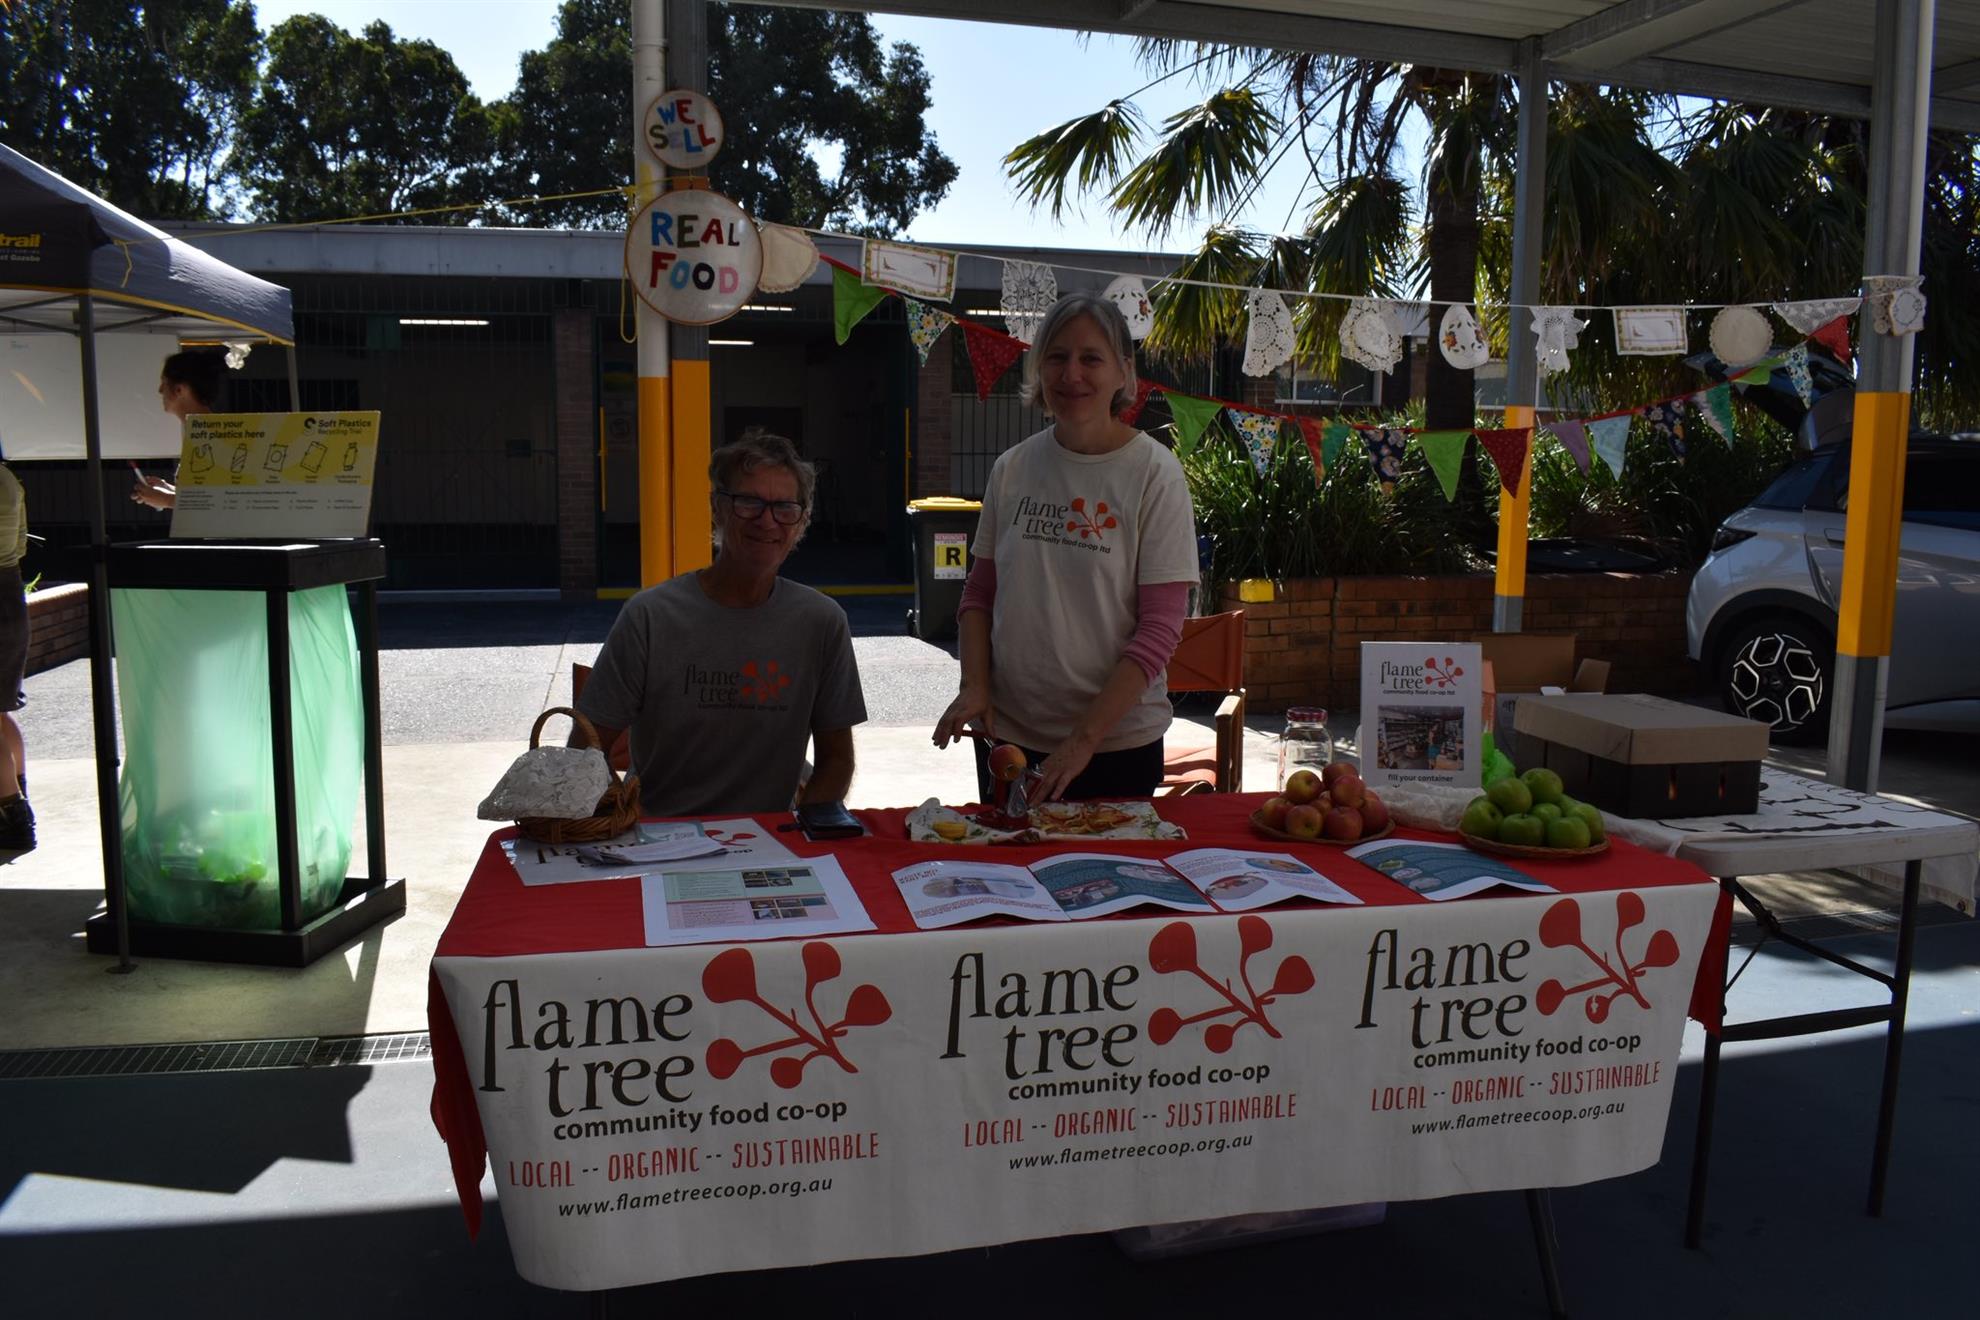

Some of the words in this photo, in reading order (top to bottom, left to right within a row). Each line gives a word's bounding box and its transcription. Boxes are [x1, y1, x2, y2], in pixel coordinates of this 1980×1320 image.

[657, 99, 695, 125] WE
[649, 124, 716, 153] SELL
[651, 211, 740, 248] REAL
[650, 251, 739, 294] FOOD
[191, 430, 207, 439] soft
[209, 430, 243, 440] plastics
[244, 430, 265, 439] here
[192, 420, 222, 429] Return
[223, 421, 244, 430] your
[318, 419, 336, 428] Soft
[338, 419, 371, 428] Plastics
[1013, 496, 1068, 525] flame
[1026, 518, 1064, 536] tree
[946, 547, 961, 565] R
[1022, 533, 1060, 545] community
[1061, 538, 1078, 547] food
[1078, 541, 1098, 551] co-op
[684, 663, 741, 695] flame
[1380, 661, 1423, 684] flame
[1393, 676, 1423, 689] tree
[1354, 928, 1531, 1029] flame
[939, 952, 1140, 1060] flame
[1410, 992, 1528, 1049] tree
[478, 978, 694, 1092] flame
[1002, 1021, 1138, 1081] tree
[1413, 1041, 1530, 1069] community
[1535, 1035, 1583, 1058] food
[1588, 1034, 1642, 1053] co-op
[544, 1055, 695, 1118] tree
[1008, 1072, 1142, 1100] community
[1147, 1066, 1201, 1089] food
[1207, 1063, 1271, 1083] co-op
[1371, 1085, 1427, 1112] LOCAL
[1451, 1075, 1525, 1105] ORGANIC
[1549, 1061, 1661, 1095] SUSTAINABLE
[553, 1107, 703, 1140] community
[710, 1103, 769, 1126] food
[776, 1102, 848, 1122] co-op
[964, 1118, 1025, 1148] LOCAL
[1054, 1107, 1137, 1138] ORGANIC
[1165, 1093, 1297, 1129] SUSTAINABLE
[1411, 1102, 1625, 1135] www.flametreecoop.org.au
[509, 1160, 575, 1188] LOCAL
[607, 1146, 700, 1182] ORGANIC
[732, 1132, 880, 1170] SUSTAINABLE
[1009, 1133, 1253, 1170] www.flametreecoop.org.au
[558, 1178, 833, 1217] www.flametreecoop.org.au
